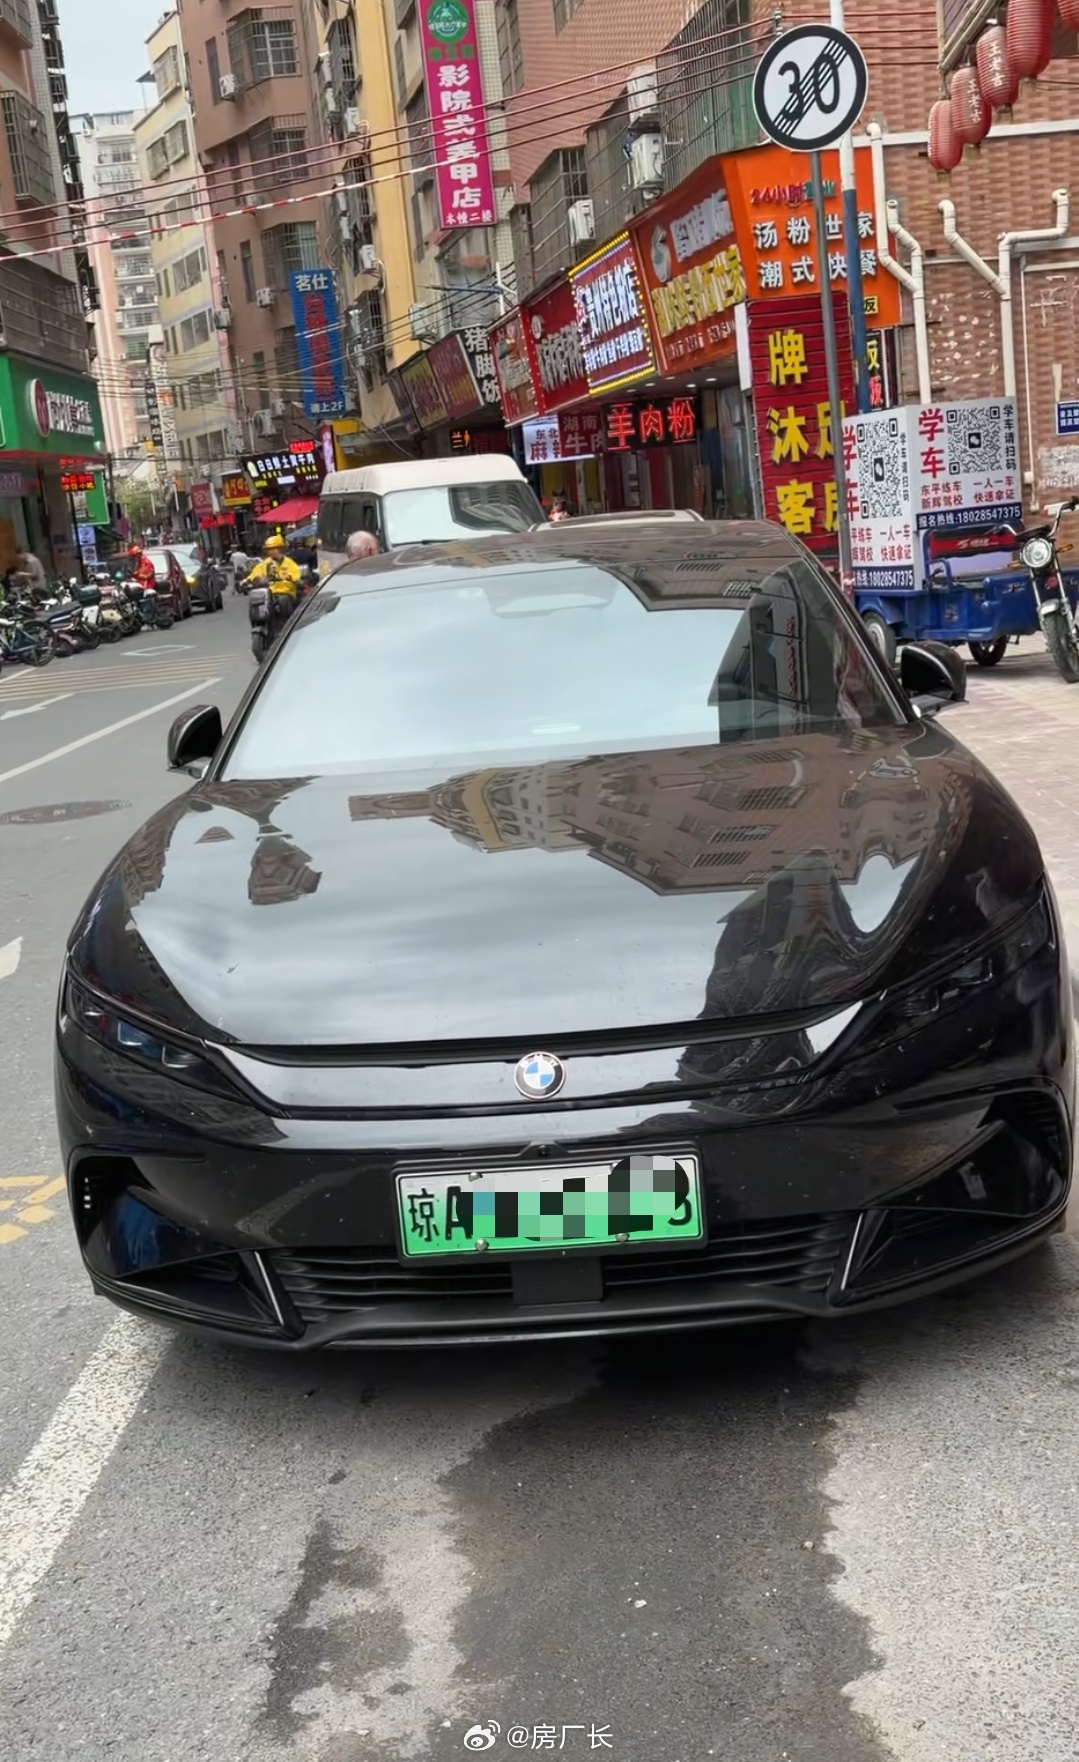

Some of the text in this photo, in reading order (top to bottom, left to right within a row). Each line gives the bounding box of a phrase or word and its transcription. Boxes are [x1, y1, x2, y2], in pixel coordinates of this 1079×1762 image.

[778, 54, 840, 120] 30
[437, 64, 482, 209] 影院式美甲店
[753, 211, 874, 249] 汤粉世家
[759, 248, 877, 288] 潮式快餐
[465, 327, 500, 403] 猪脚饭
[768, 329, 808, 385] 牌
[536, 428, 559, 439] 东北
[564, 416, 598, 431] 湖南
[607, 401, 696, 448] 羊肉粉
[918, 408, 946, 478] 学车
[1002, 404, 1016, 471] 学车请扫码
[921, 476, 1015, 495] 东平练车 一人一车
[974, 489, 1015, 504] 快速拿证
[852, 525, 911, 542] 平练车 一人一车
[918, 505, 1021, 528] 报名热线:18028547375
